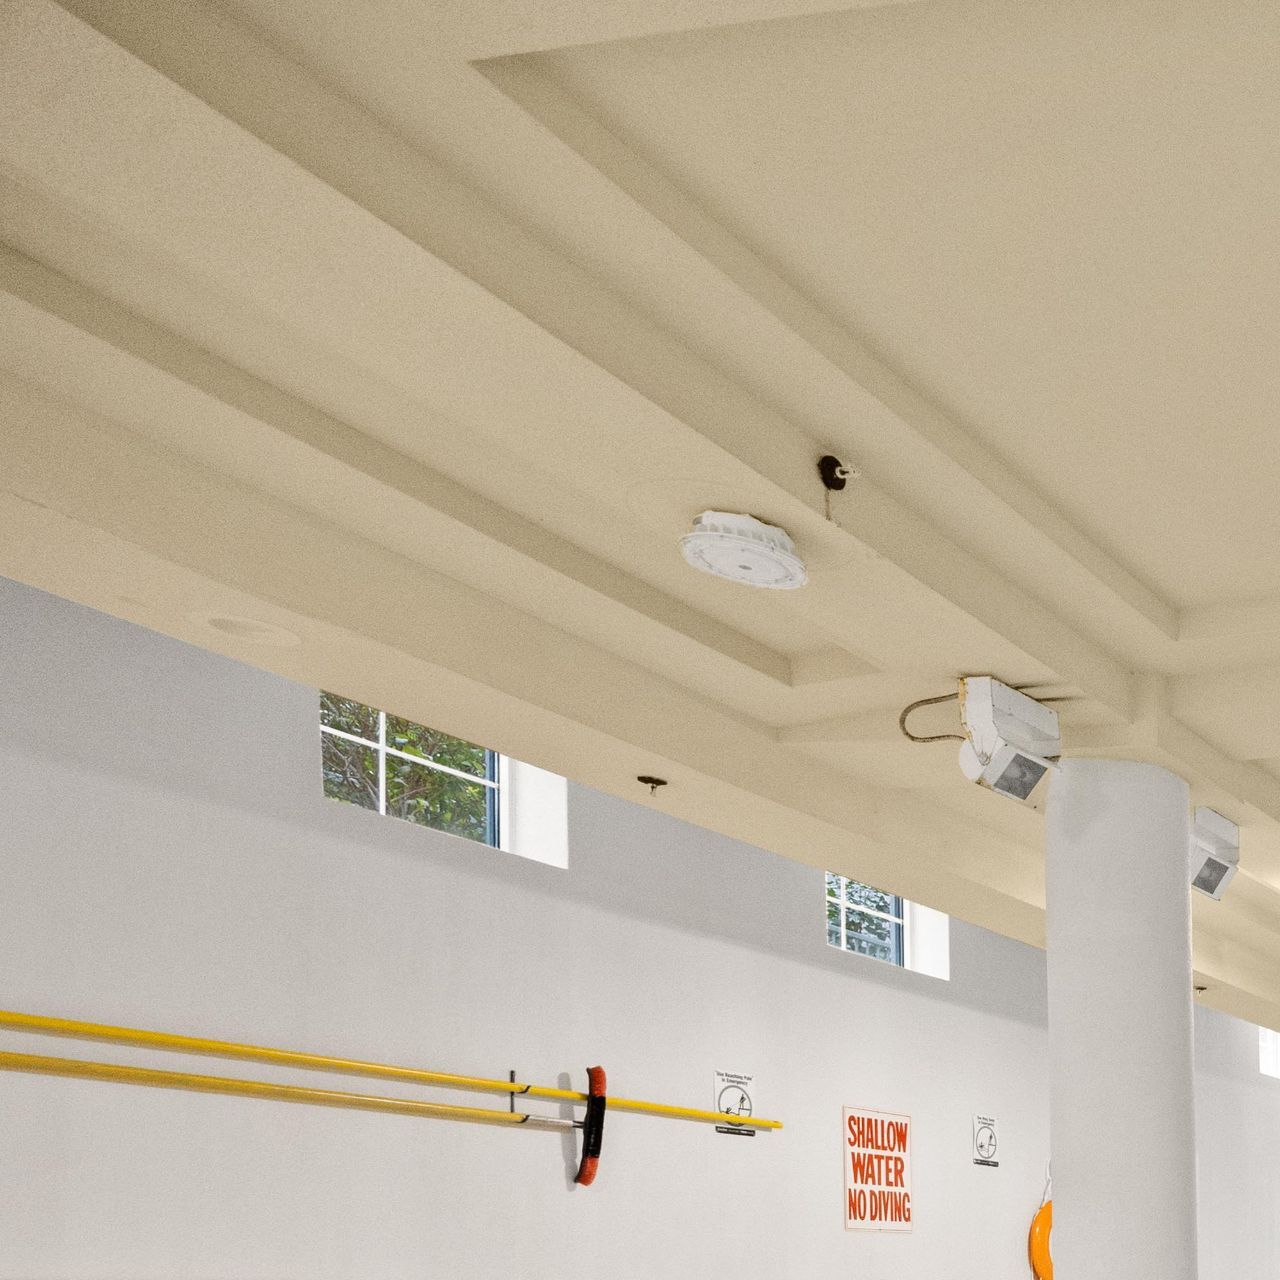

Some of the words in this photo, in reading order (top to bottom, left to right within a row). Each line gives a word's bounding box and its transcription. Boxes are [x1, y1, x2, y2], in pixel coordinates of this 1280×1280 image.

[847, 1115, 908, 1153] SHALLOW
[851, 1151, 905, 1188] WATER
[848, 1188, 867, 1221] NO
[869, 1189, 911, 1222] DIVING
